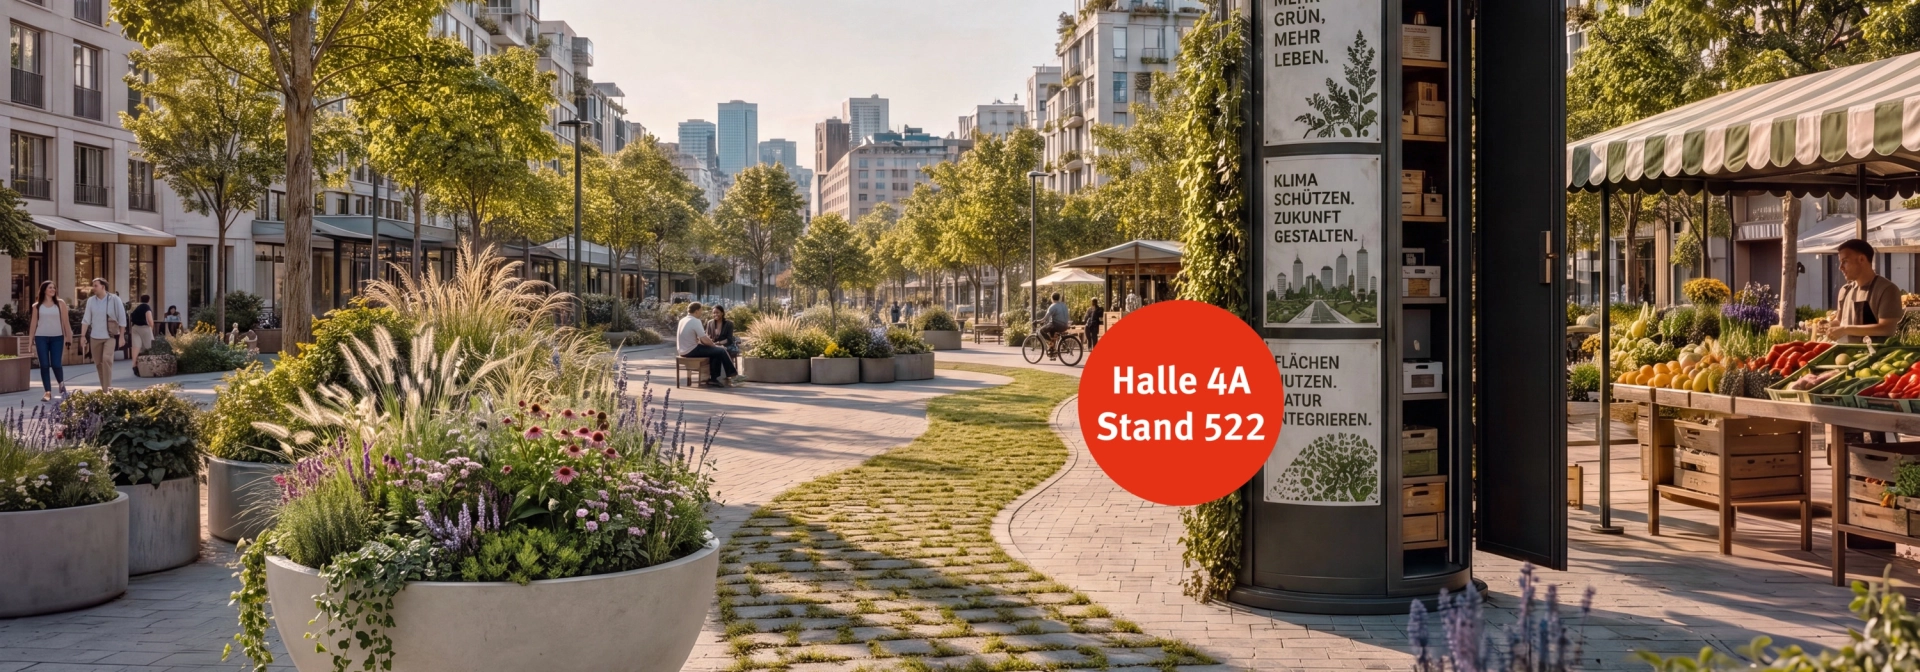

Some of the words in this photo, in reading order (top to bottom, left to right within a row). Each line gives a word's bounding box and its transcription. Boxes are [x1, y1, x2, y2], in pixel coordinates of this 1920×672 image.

[1274, 6, 1326, 27] GRÜN,
[1274, 29, 1321, 47] MEHR
[1274, 50, 1329, 67] LEBEN.
[1274, 173, 1318, 188] KLIMA
[1274, 189, 1355, 207] SCHÜTZEN.
[1274, 210, 1341, 225] ZUKUNFT
[1274, 229, 1358, 243] GESTALTEN.
[1281, 374, 1337, 388] UTZEN.
[1284, 393, 1322, 407] ATUR
[1282, 412, 1372, 426] NTEGRIEREN.
